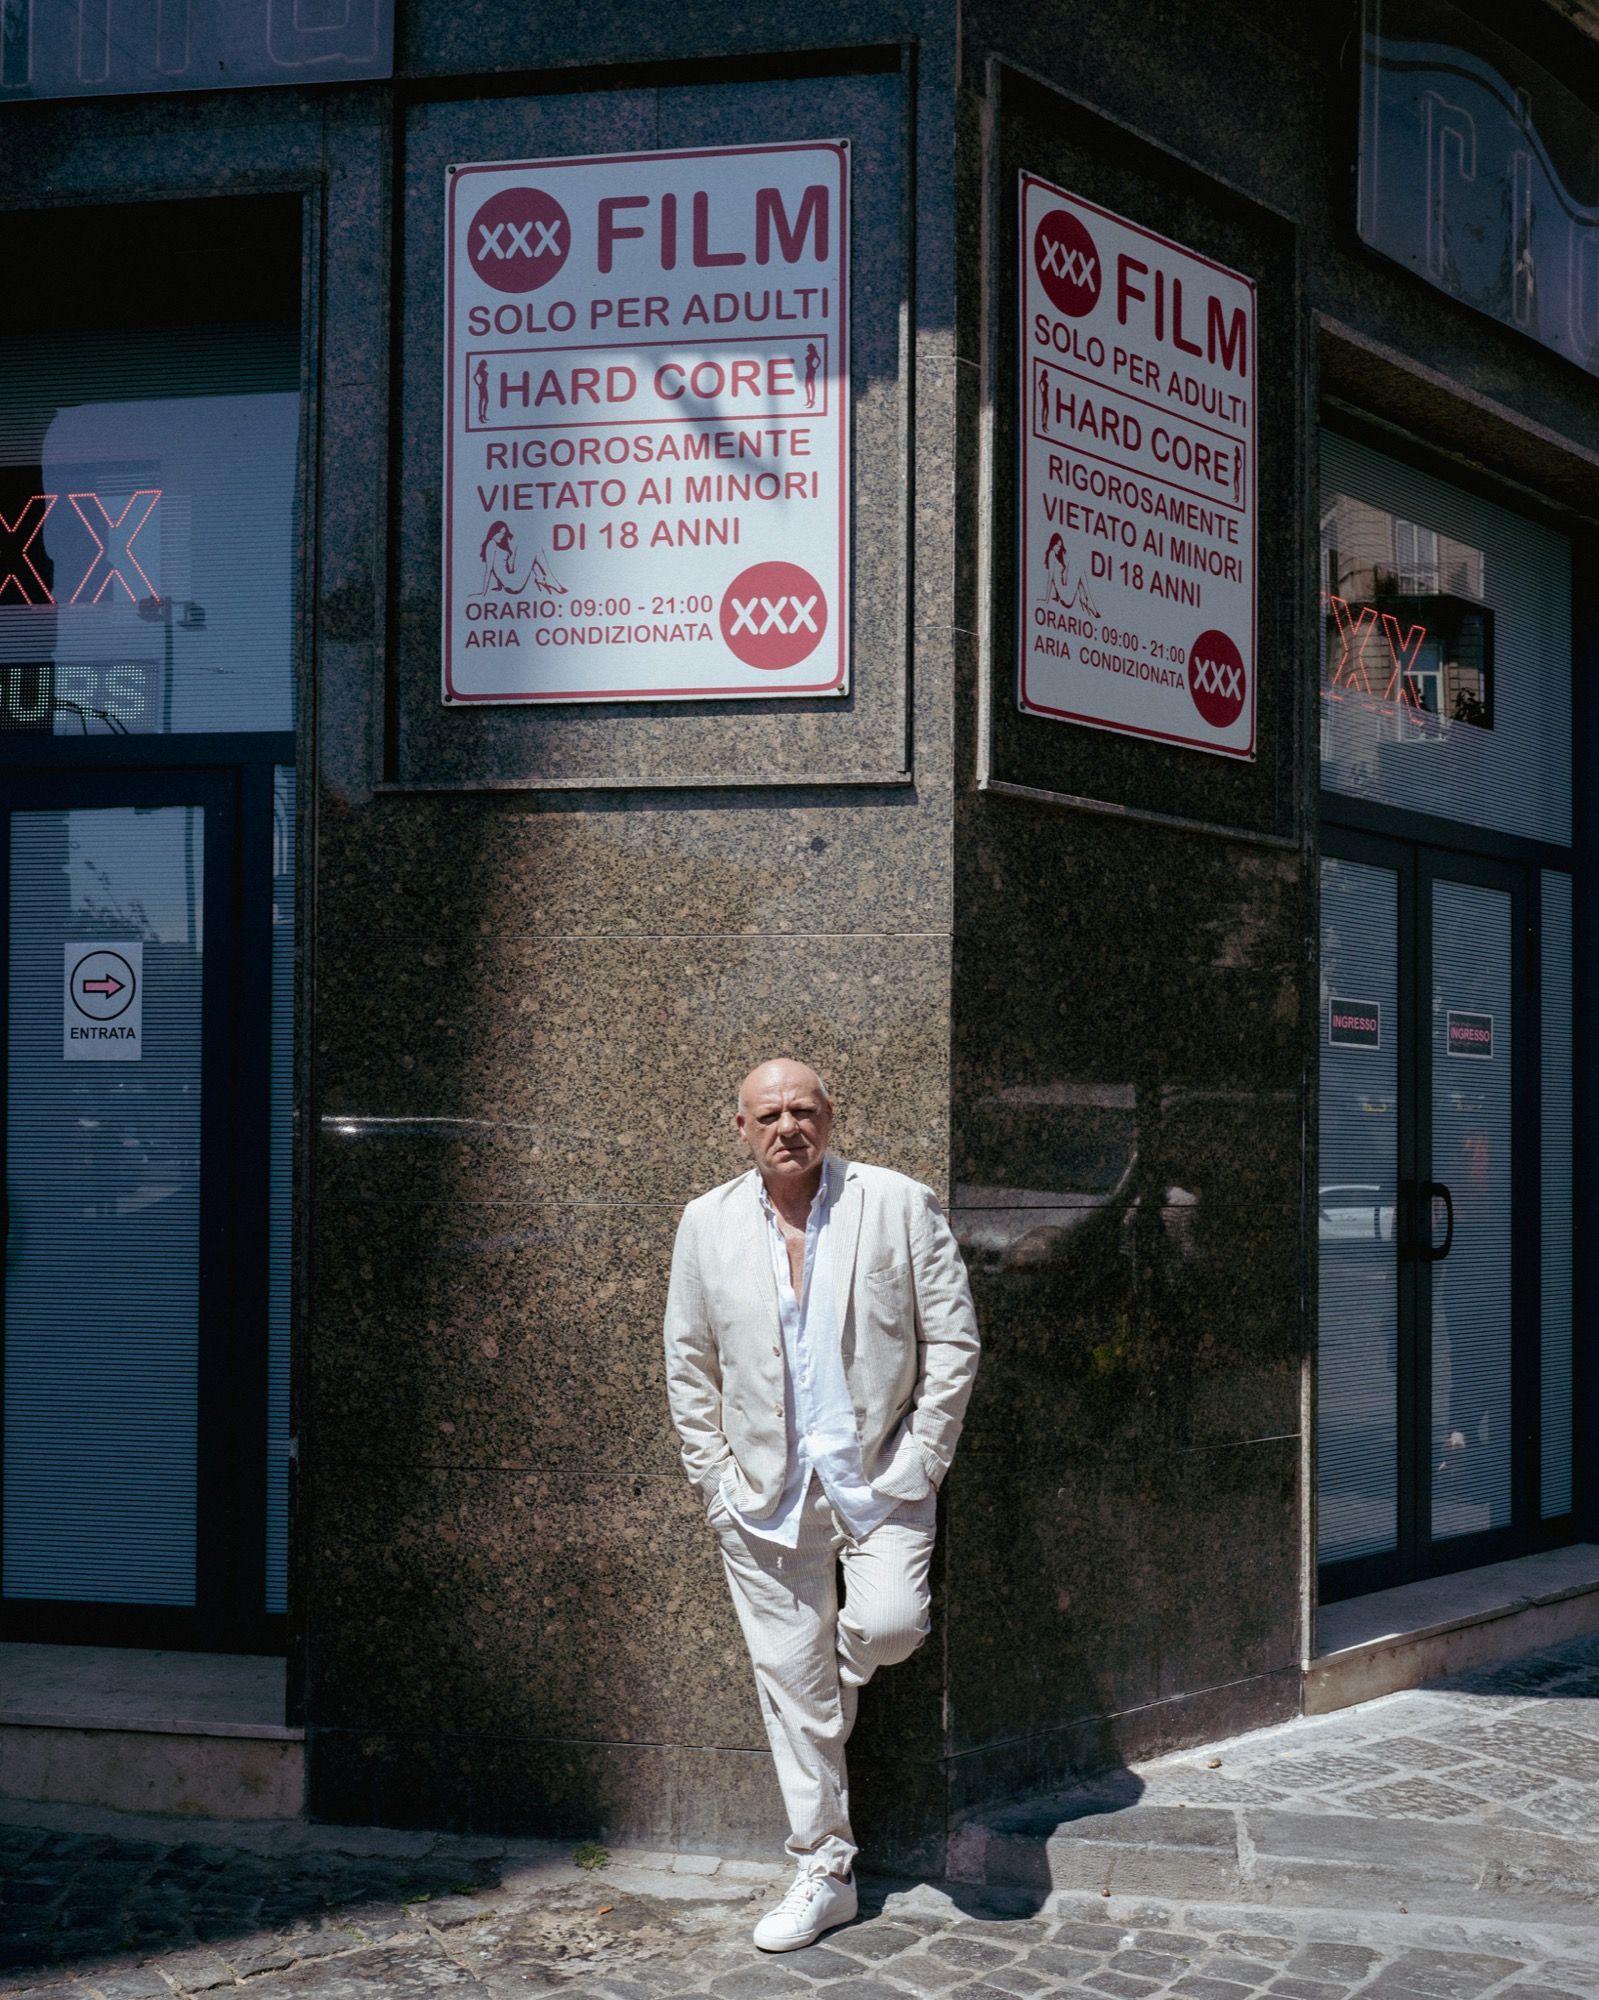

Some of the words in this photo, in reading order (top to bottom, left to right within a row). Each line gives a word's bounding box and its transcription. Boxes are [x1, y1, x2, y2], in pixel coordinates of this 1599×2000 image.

[477, 219, 562, 261] XXX
[598, 184, 829, 274] FILM
[1041, 234, 1096, 293] XXX
[468, 300, 576, 336] SOLO
[590, 296, 670, 330] PER
[683, 287, 829, 325] ADULTI
[1117, 253, 1246, 378] FILM
[500, 365, 637, 408] HARD
[654, 358, 796, 400] CORE
[1035, 314, 1105, 367] SOLO
[1114, 346, 1160, 393] PER
[1168, 371, 1246, 428] ADULTI
[486, 428, 811, 470] RIGOROSAMENTE
[1056, 388, 1142, 451] HARD
[1151, 427, 1229, 486] CORE
[477, 479, 626, 512] VIETATO
[637, 477, 673, 506] AI
[685, 471, 818, 504] MINORI
[1049, 454, 1239, 544] RIGOROSAMENTE
[552, 522, 586, 551] DI
[599, 520, 639, 549] 18
[650, 517, 740, 548] ANNI
[1043, 493, 1137, 548] VIETATO
[1143, 528, 1163, 557] AI
[1170, 536, 1242, 583] MINORI
[1091, 550, 1112, 582] DI
[1120, 561, 1144, 590] 18
[1150, 570, 1200, 608] ANNI
[465, 599, 562, 621] ORARIO:
[570, 597, 631, 617] 09:00
[651, 595, 713, 615] 21:00
[730, 595, 818, 636] XXX
[465, 628, 521, 648] ARIA
[535, 622, 713, 646] CONDIZIONATA
[1034, 607, 1098, 640] ORARIO:
[1102, 626, 1139, 651] 09:00
[1150, 640, 1185, 665] 21:00
[1034, 635, 1071, 660] ARIA
[1079, 646, 1185, 690] CONDIZIONATA
[1194, 656, 1242, 701] XXX
[0, 665, 146, 721] URS
[70, 1027, 136, 1039] ENTRATA
[1332, 1015, 1377, 1032] INGRESSO
[1450, 1027, 1490, 1042] INGRESSO
